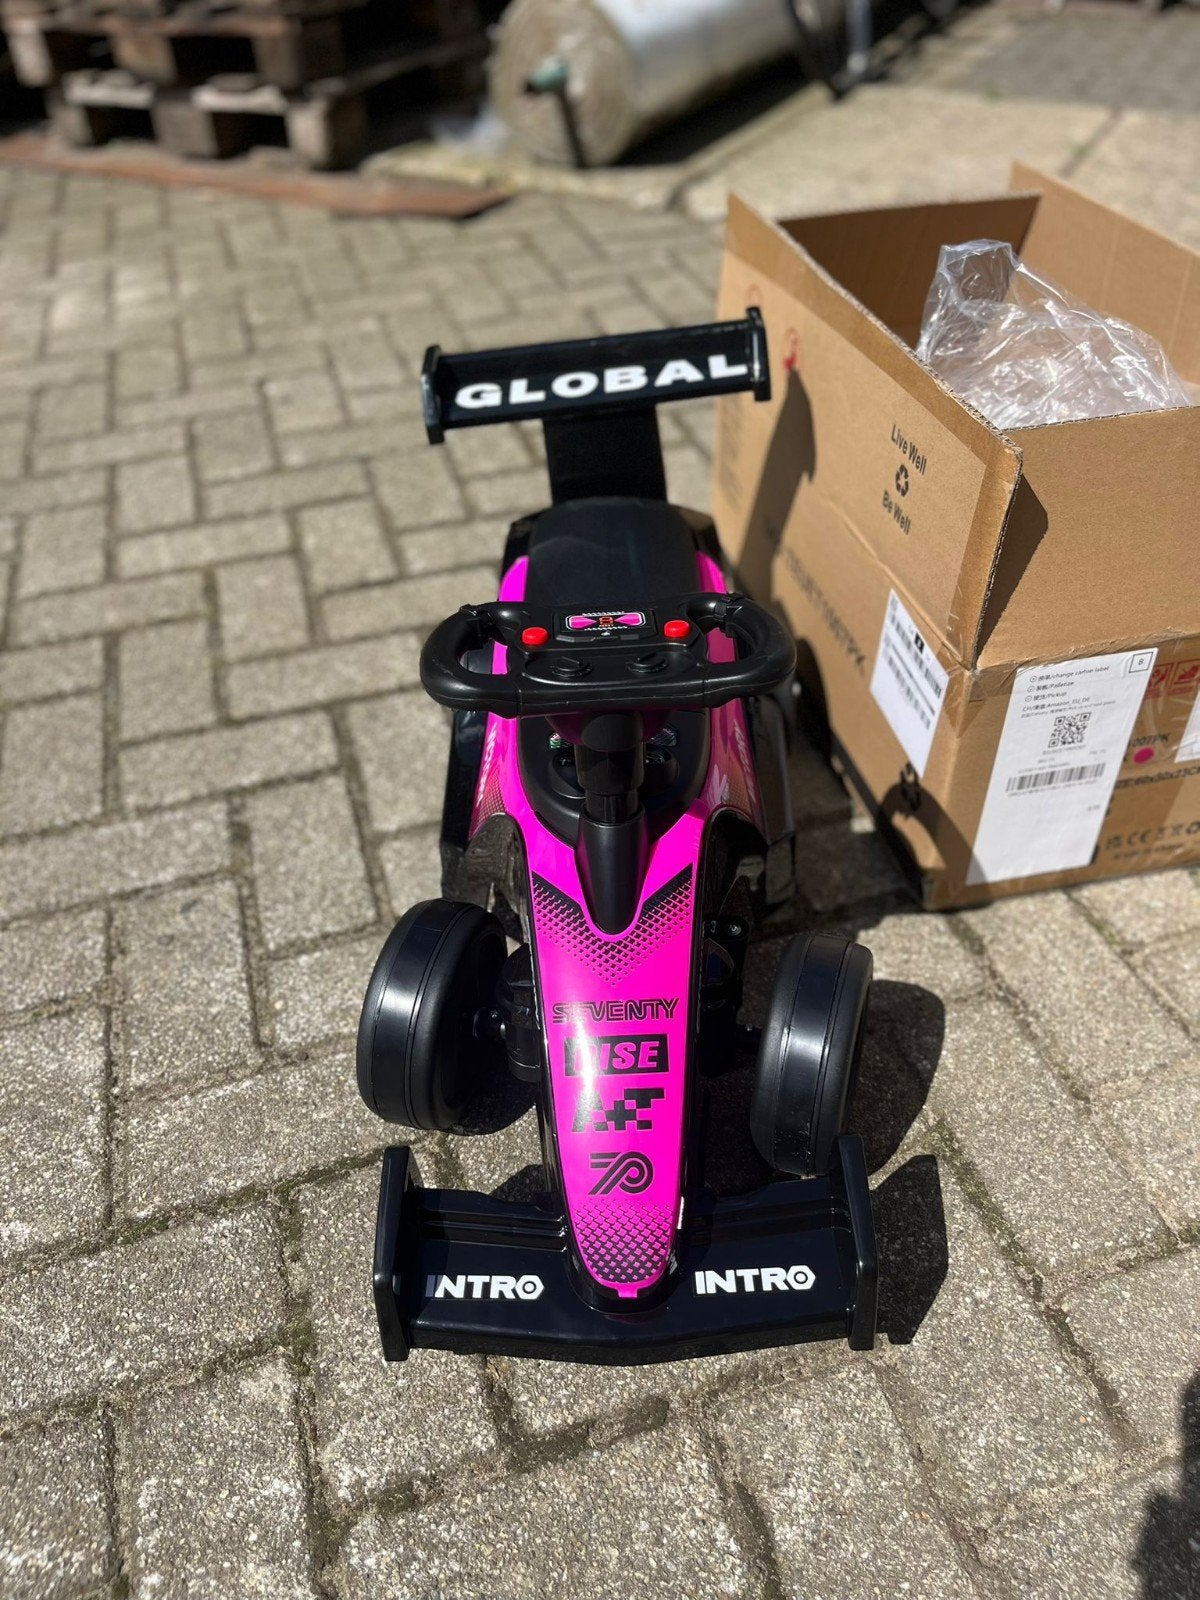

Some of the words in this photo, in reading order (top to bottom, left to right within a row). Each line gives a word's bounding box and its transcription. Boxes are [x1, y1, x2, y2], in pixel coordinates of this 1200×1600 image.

[455, 354, 748, 409] GLOBAL
[891, 423, 908, 455] Live
[908, 441, 927, 475] Well
[882, 489, 893, 514] Be
[893, 502, 911, 536] Well
[1094, 665, 1110, 673] label
[425, 1274, 545, 1300] INTRO
[694, 1264, 816, 1295] INTRO
